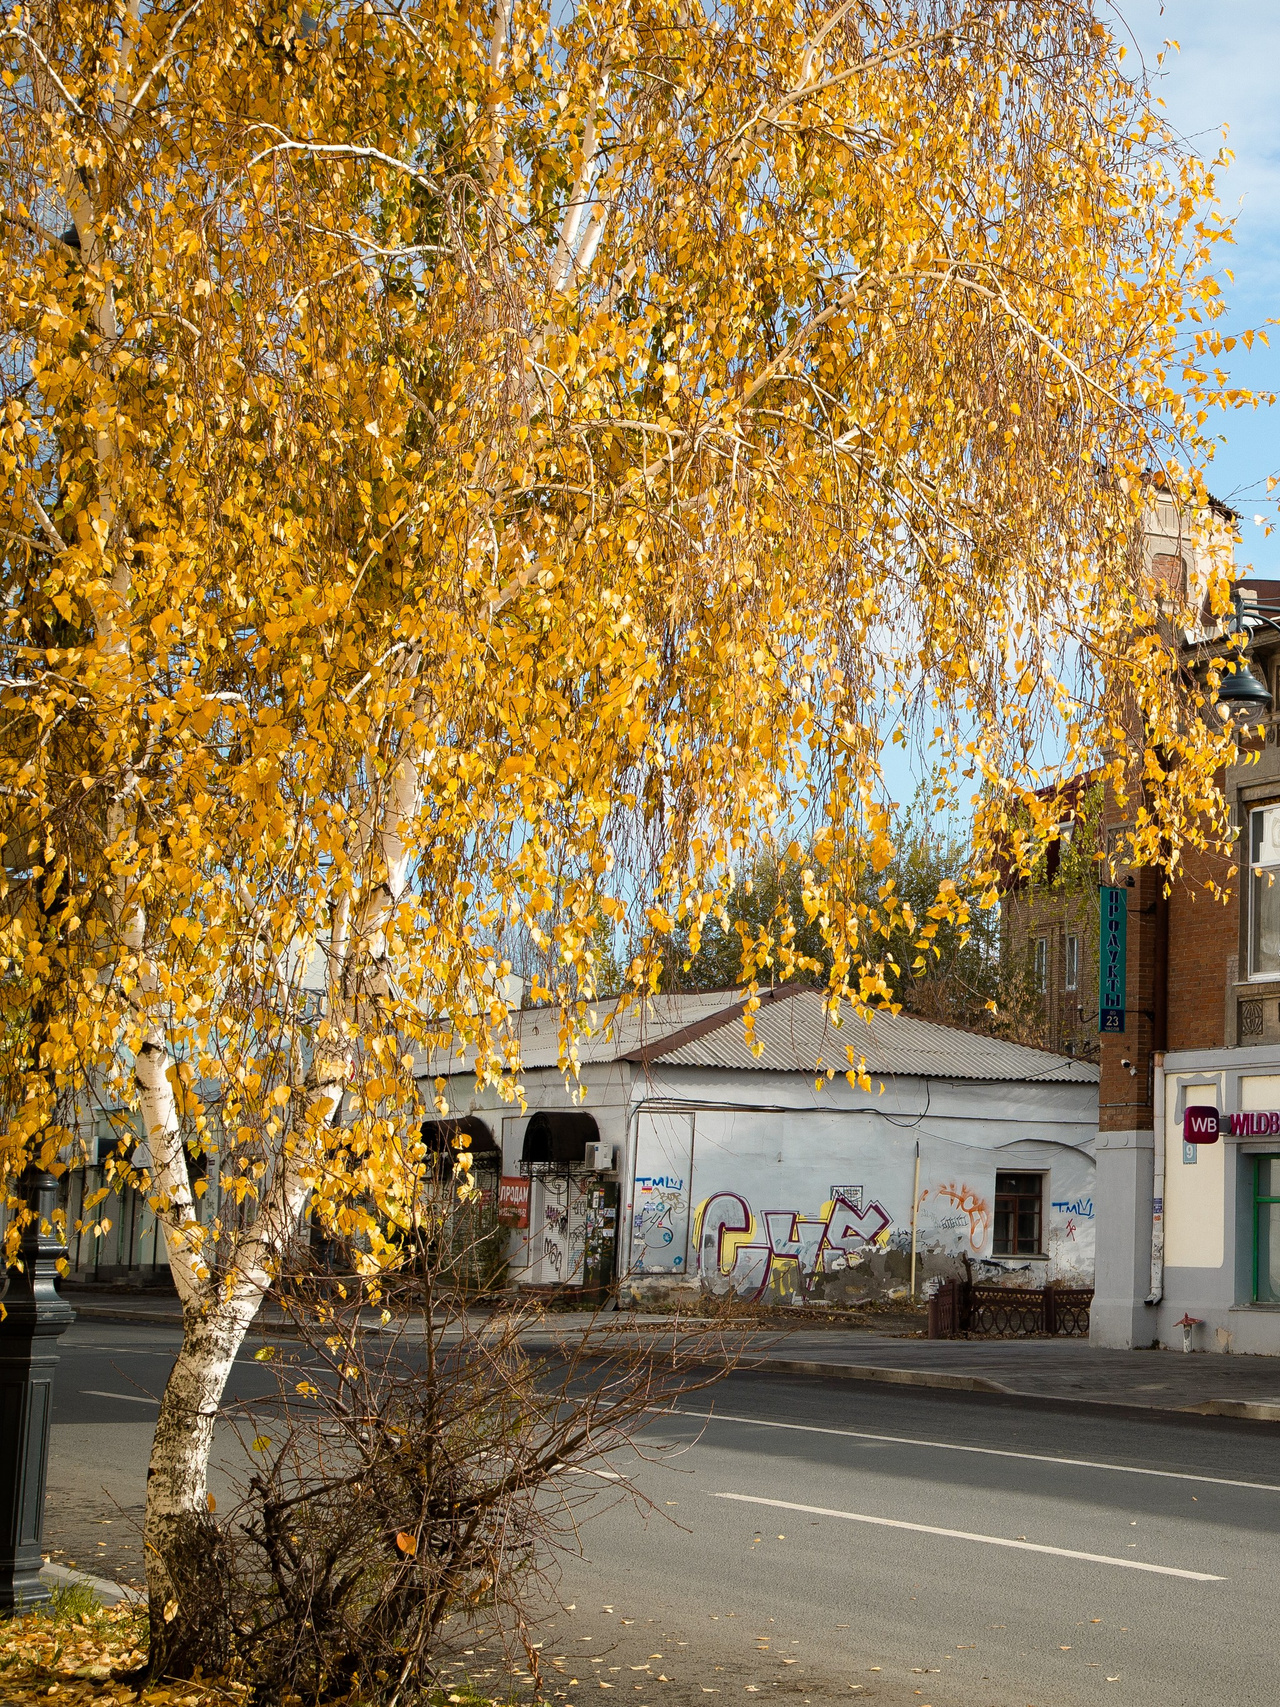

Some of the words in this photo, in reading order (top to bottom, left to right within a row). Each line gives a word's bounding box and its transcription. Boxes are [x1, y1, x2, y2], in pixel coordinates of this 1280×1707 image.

[1105, 889, 1121, 1007] ПРОДУКТЫ
[1106, 1015, 1119, 1026] 23
[1191, 1117, 1217, 1133] WB
[1186, 1144, 1194, 1159] 9
